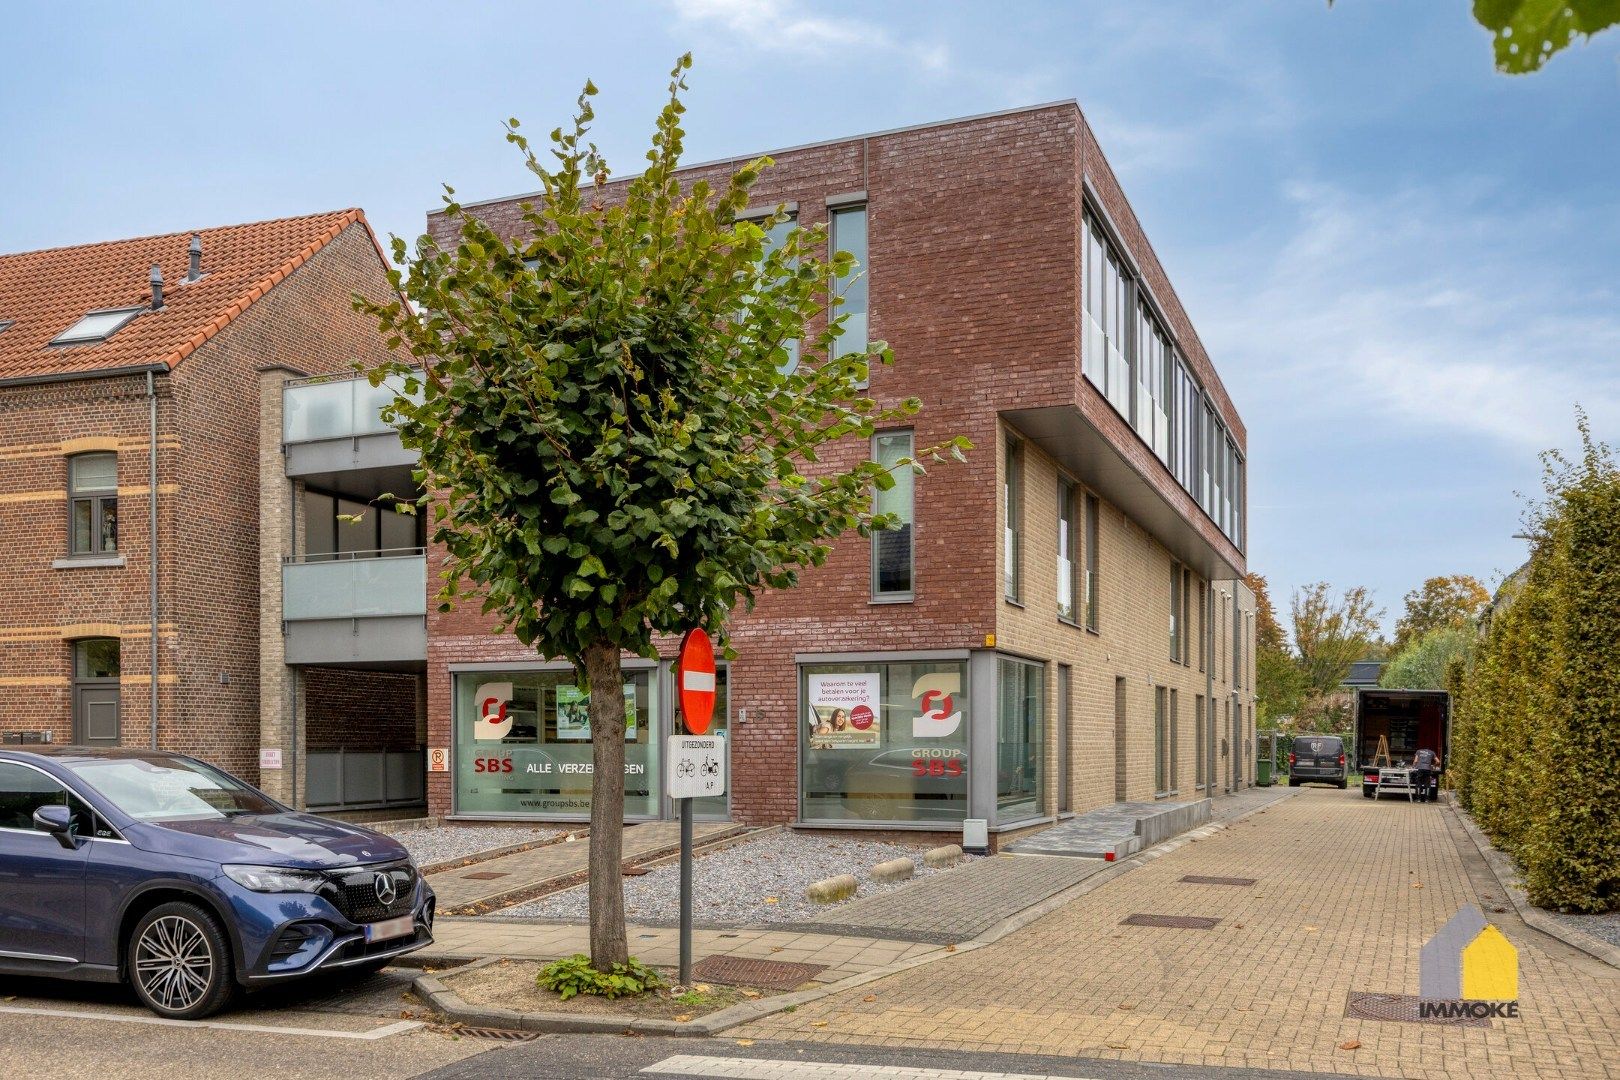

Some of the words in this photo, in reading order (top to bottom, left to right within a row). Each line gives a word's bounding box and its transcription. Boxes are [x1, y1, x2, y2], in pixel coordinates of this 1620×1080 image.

[818, 695, 870, 703] autoverzekering?
[682, 740, 715, 749] UITGEZONDERD
[911, 748, 961, 758] GROUP
[474, 758, 513, 773] SBS
[526, 763, 552, 774] ALLE
[558, 763, 644, 774] VERZEGEN
[911, 757, 963, 777] SBS
[520, 800, 590, 809] www.groupsbs.be
